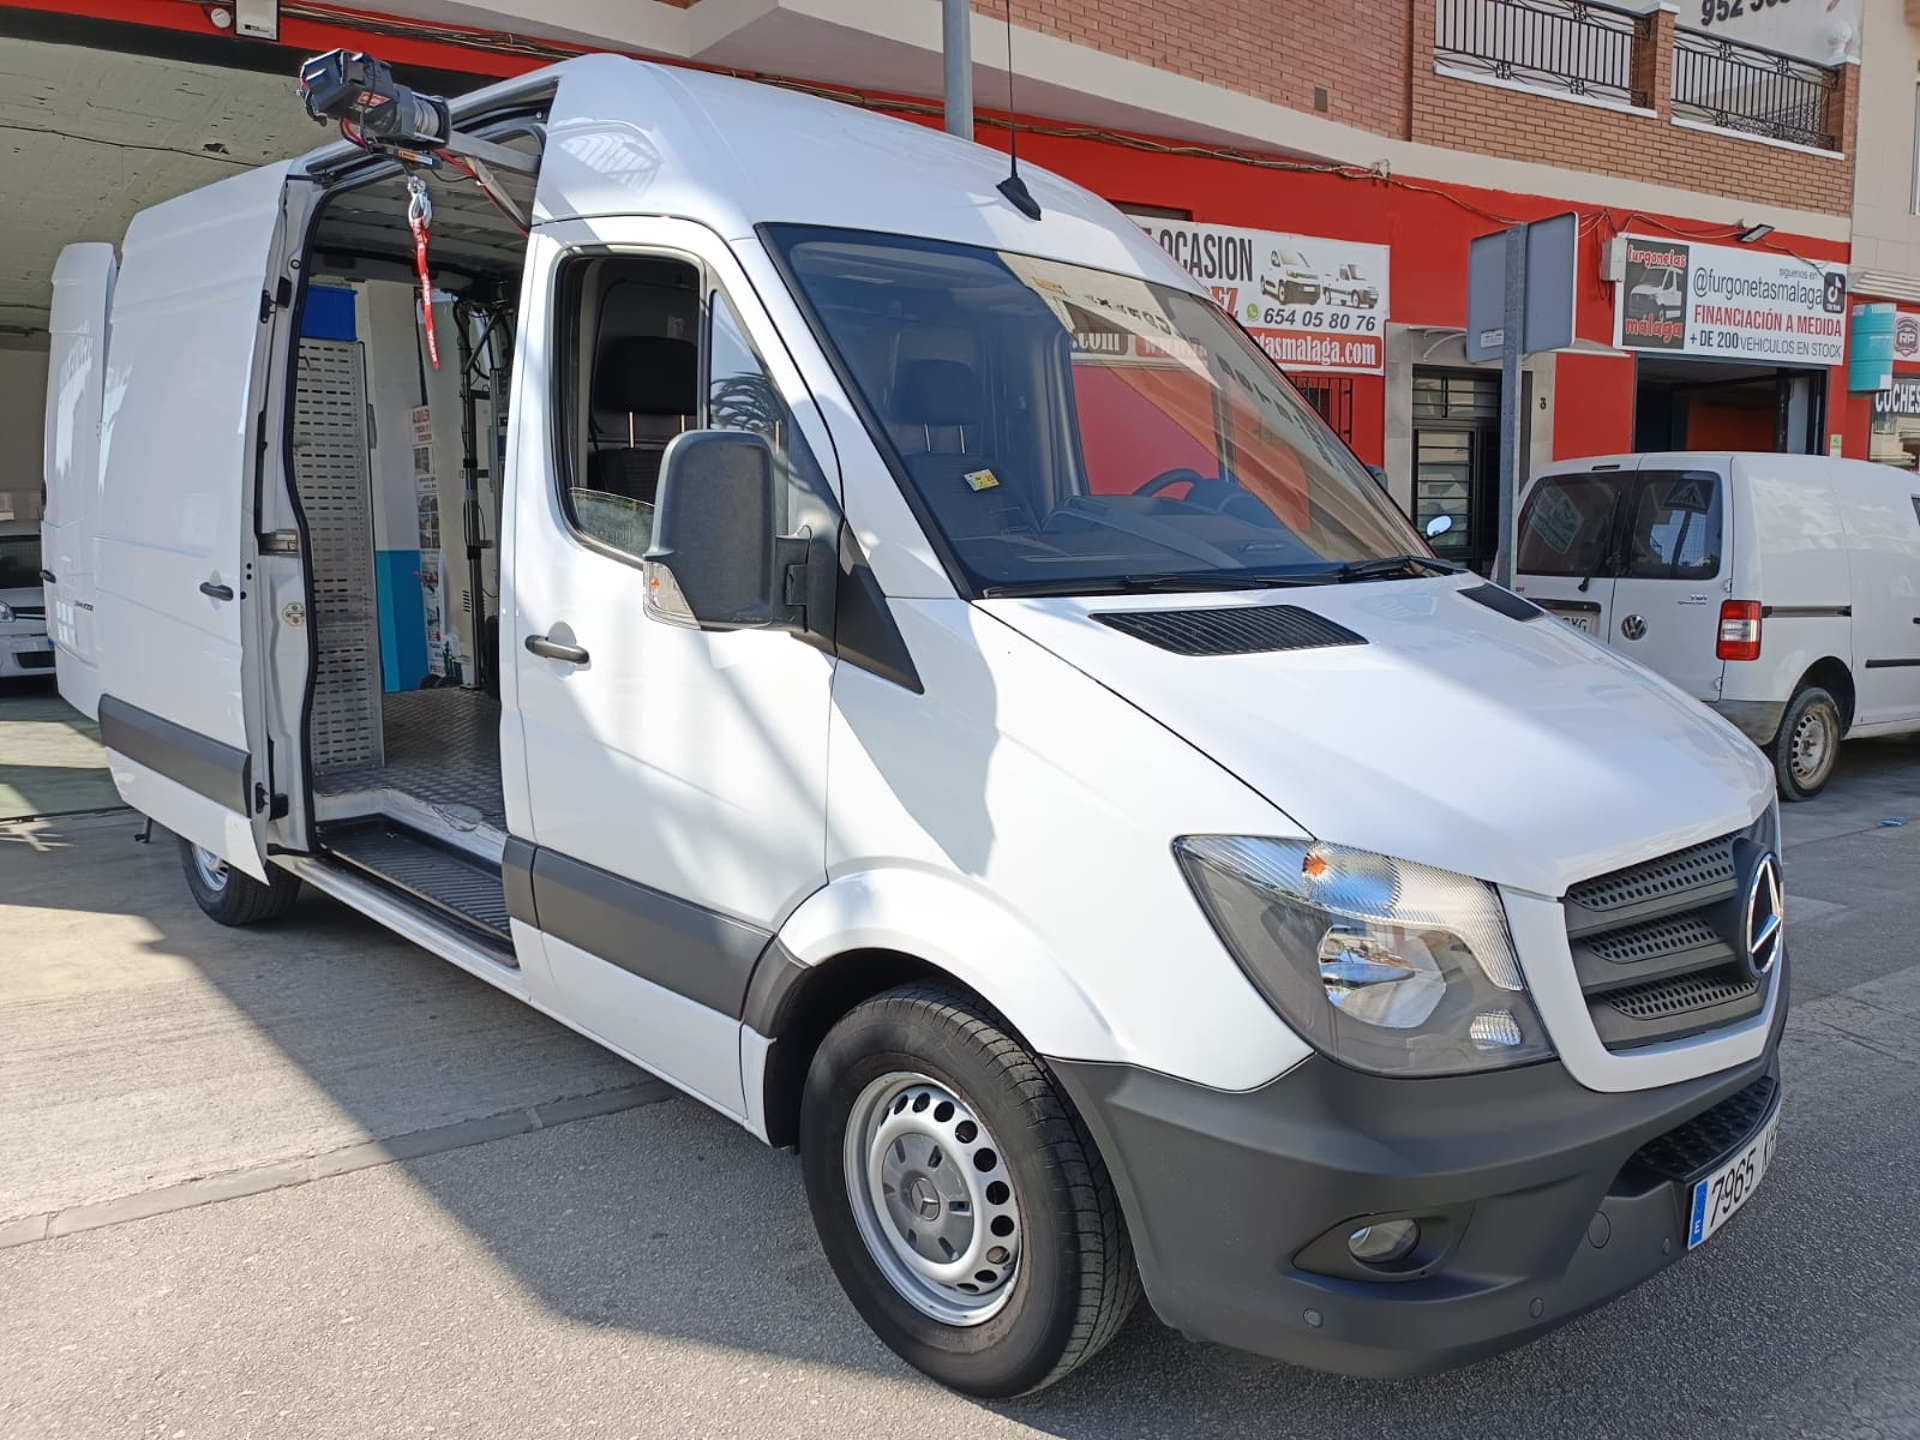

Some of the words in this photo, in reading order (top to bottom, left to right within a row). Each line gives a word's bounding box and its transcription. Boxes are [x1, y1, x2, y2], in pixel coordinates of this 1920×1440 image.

[1693, 267, 1822, 310] @furgonetasmalaga
[1264, 308, 1296, 325] 654
[1302, 311, 1324, 327] 05
[1329, 313, 1350, 330] 80
[1356, 315, 1376, 331] 76
[1694, 304, 1782, 331] FINANCIACIÓN
[1785, 315, 1793, 333] A
[1797, 316, 1842, 336] MEDIDA
[1700, 330, 1714, 347] DE
[1717, 332, 1738, 349] 200
[1740, 336, 1795, 354] VEHICULOS
[1797, 341, 1809, 355] EN
[1811, 343, 1842, 358] STOCK
[1710, 1147, 1757, 1229] 7965
